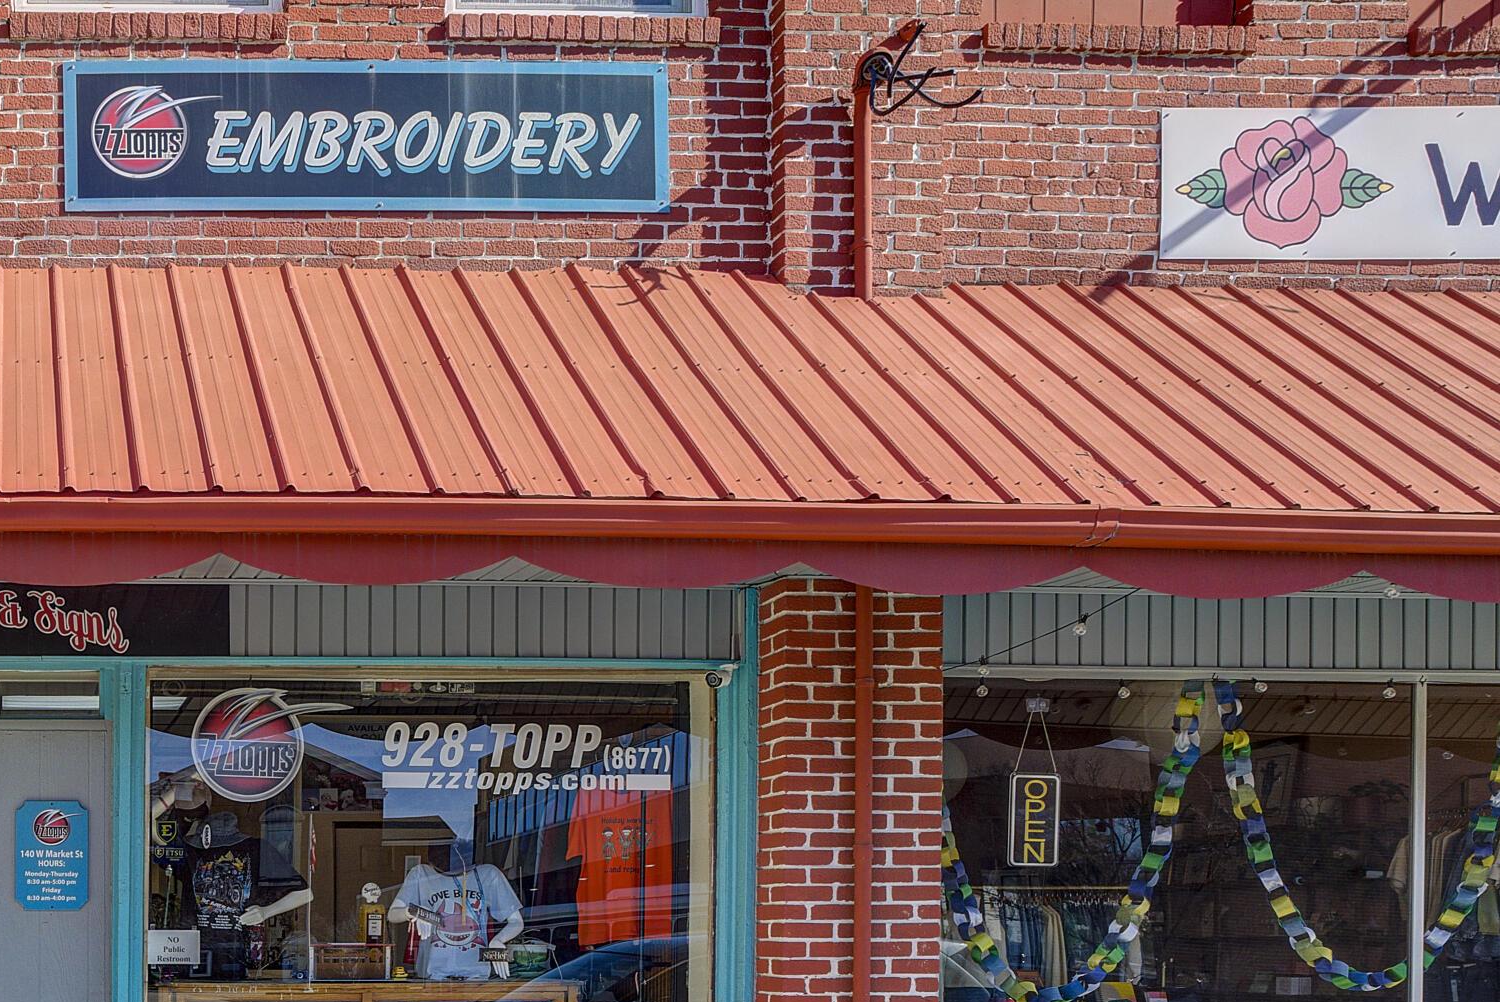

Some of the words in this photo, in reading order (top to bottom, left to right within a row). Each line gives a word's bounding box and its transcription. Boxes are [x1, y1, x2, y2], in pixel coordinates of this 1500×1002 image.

[205, 110, 642, 178] EMBROIDERY
[1424, 143, 1500, 226] W
[27, 590, 129, 653] Signs
[382, 722, 602, 769] 928-TOPP
[603, 745, 671, 772] (8677)
[428, 769, 627, 795] zztopps.com
[1023, 779, 1048, 863] OPEN
[20, 850, 35, 858] 140
[36, 850, 44, 858] W
[45, 850, 73, 858] Market
[75, 850, 84, 858] St
[24, 870, 79, 878] Monday-Thursday
[427, 889, 450, 907] LOVE
[453, 890, 482, 900] BTES
[163, 946, 186, 954] Public
[167, 936, 180, 944] NO
[157, 955, 191, 963] Restroom
